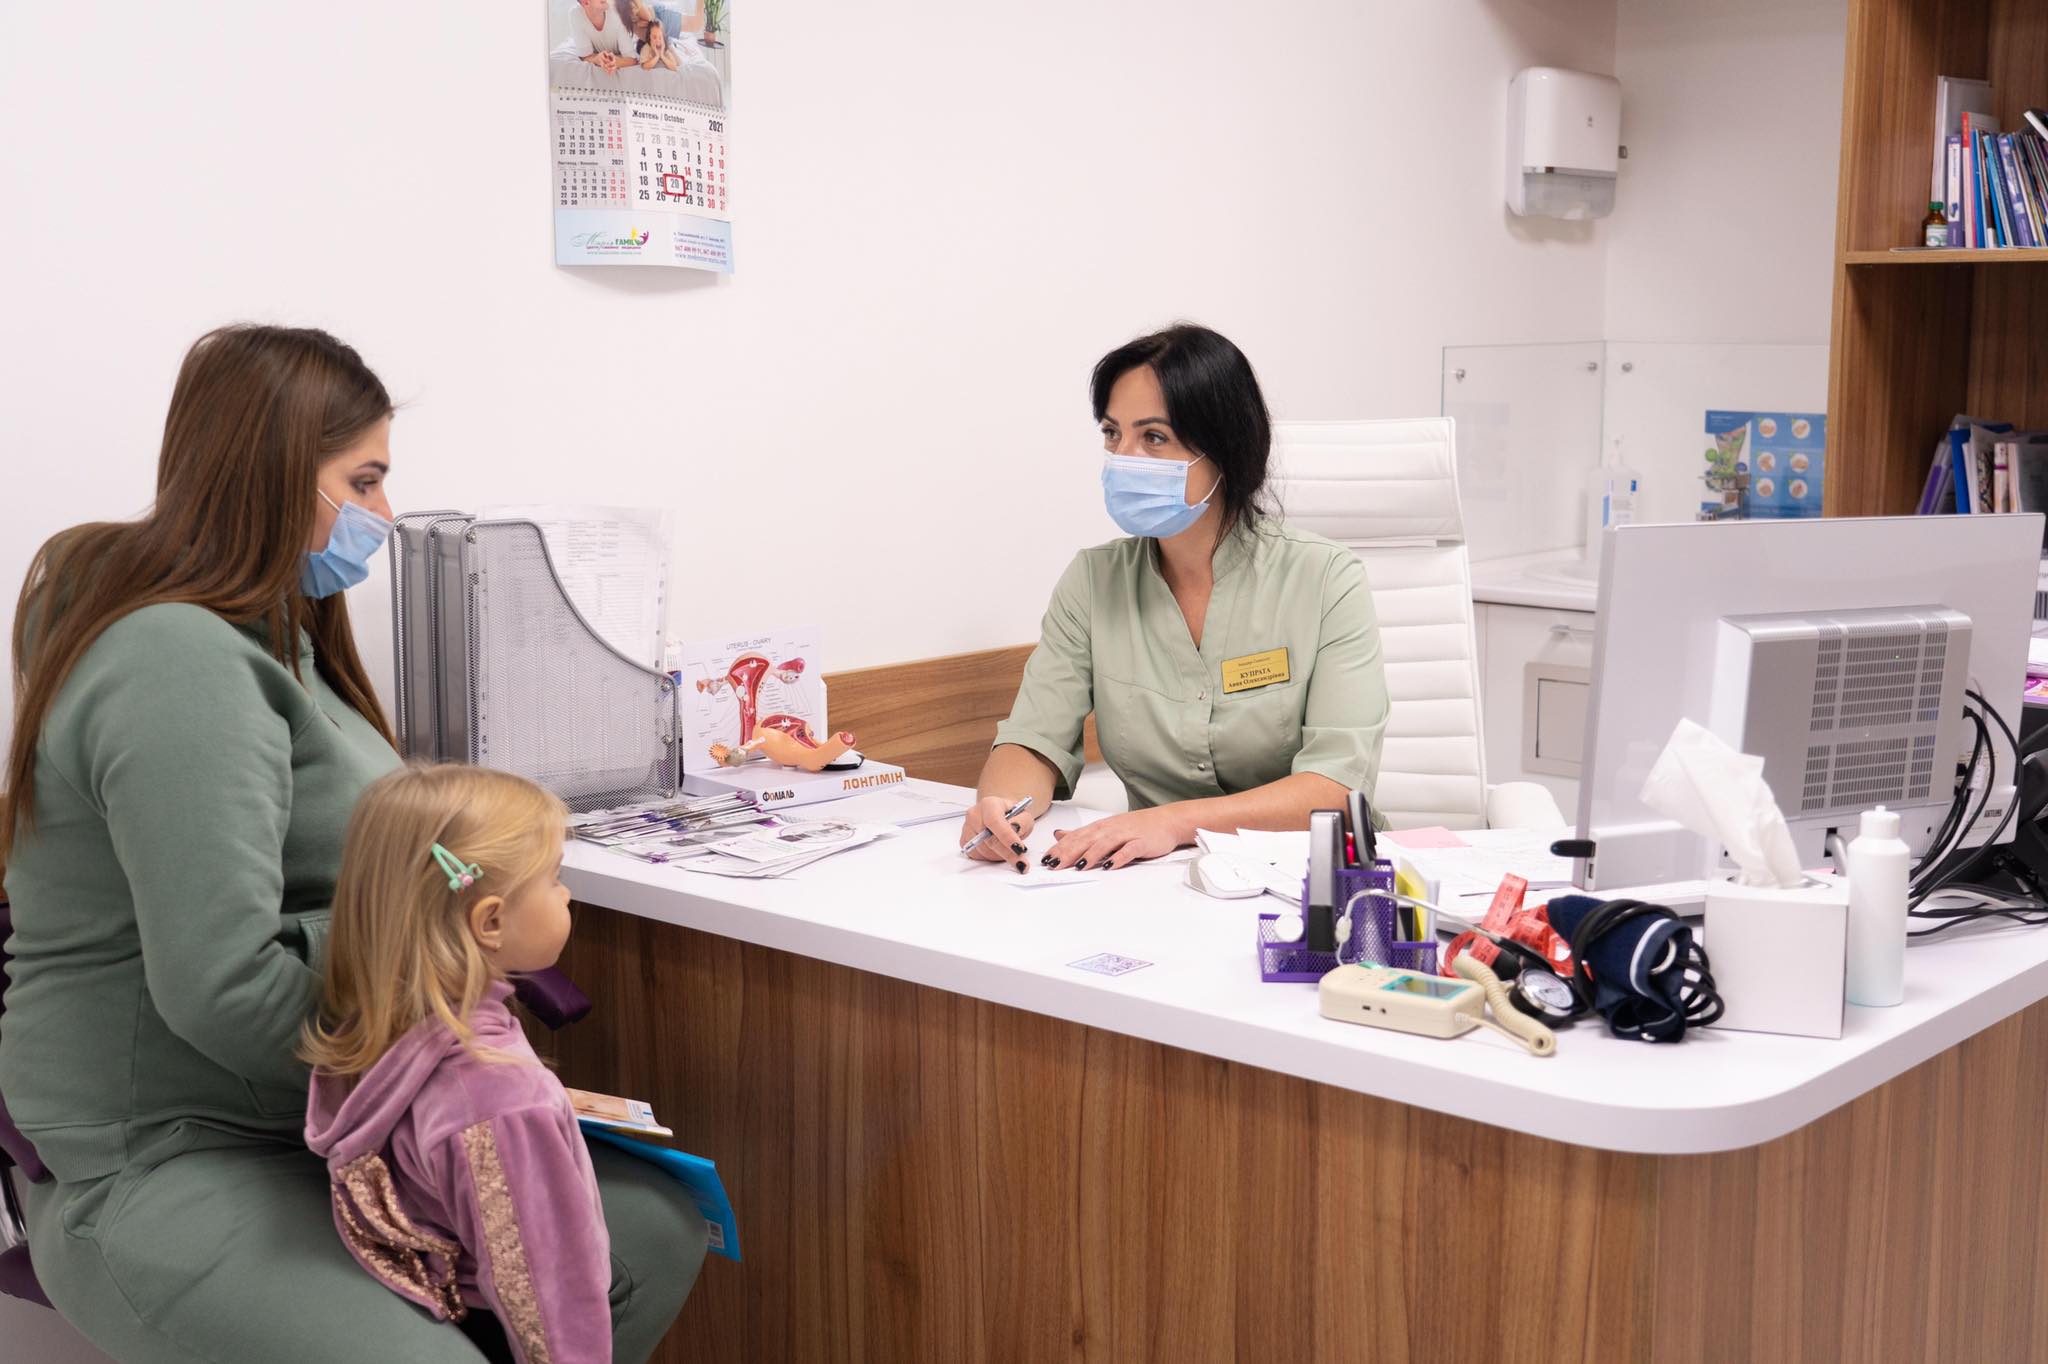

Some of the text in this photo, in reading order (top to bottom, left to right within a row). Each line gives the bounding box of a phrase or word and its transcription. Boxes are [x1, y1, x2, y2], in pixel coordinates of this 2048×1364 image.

[632, 110, 659, 120] Жовтень
[664, 113, 685, 124] October
[708, 119, 724, 133] 2021
[636, 132, 645, 142] 27
[651, 134, 661, 144] 28
[666, 135, 676, 146] 29
[640, 161, 725, 183] 11 12 13 14 15 16 17
[719, 159, 724, 169] 10
[639, 176, 725, 197] 18 19 20 21 22 23 24
[639, 189, 650, 200] 25
[656, 190, 666, 201] 26
[673, 194, 681, 203] 27
[686, 195, 693, 205] 28
[697, 196, 704, 206] 29
[707, 198, 715, 209] 30
[726, 641, 749, 650] UTERUS
[753, 637, 772, 646] OVARY
[1240, 667, 1271, 679] КУПРАТА
[843, 772, 903, 790] ЛОНГІМІН
